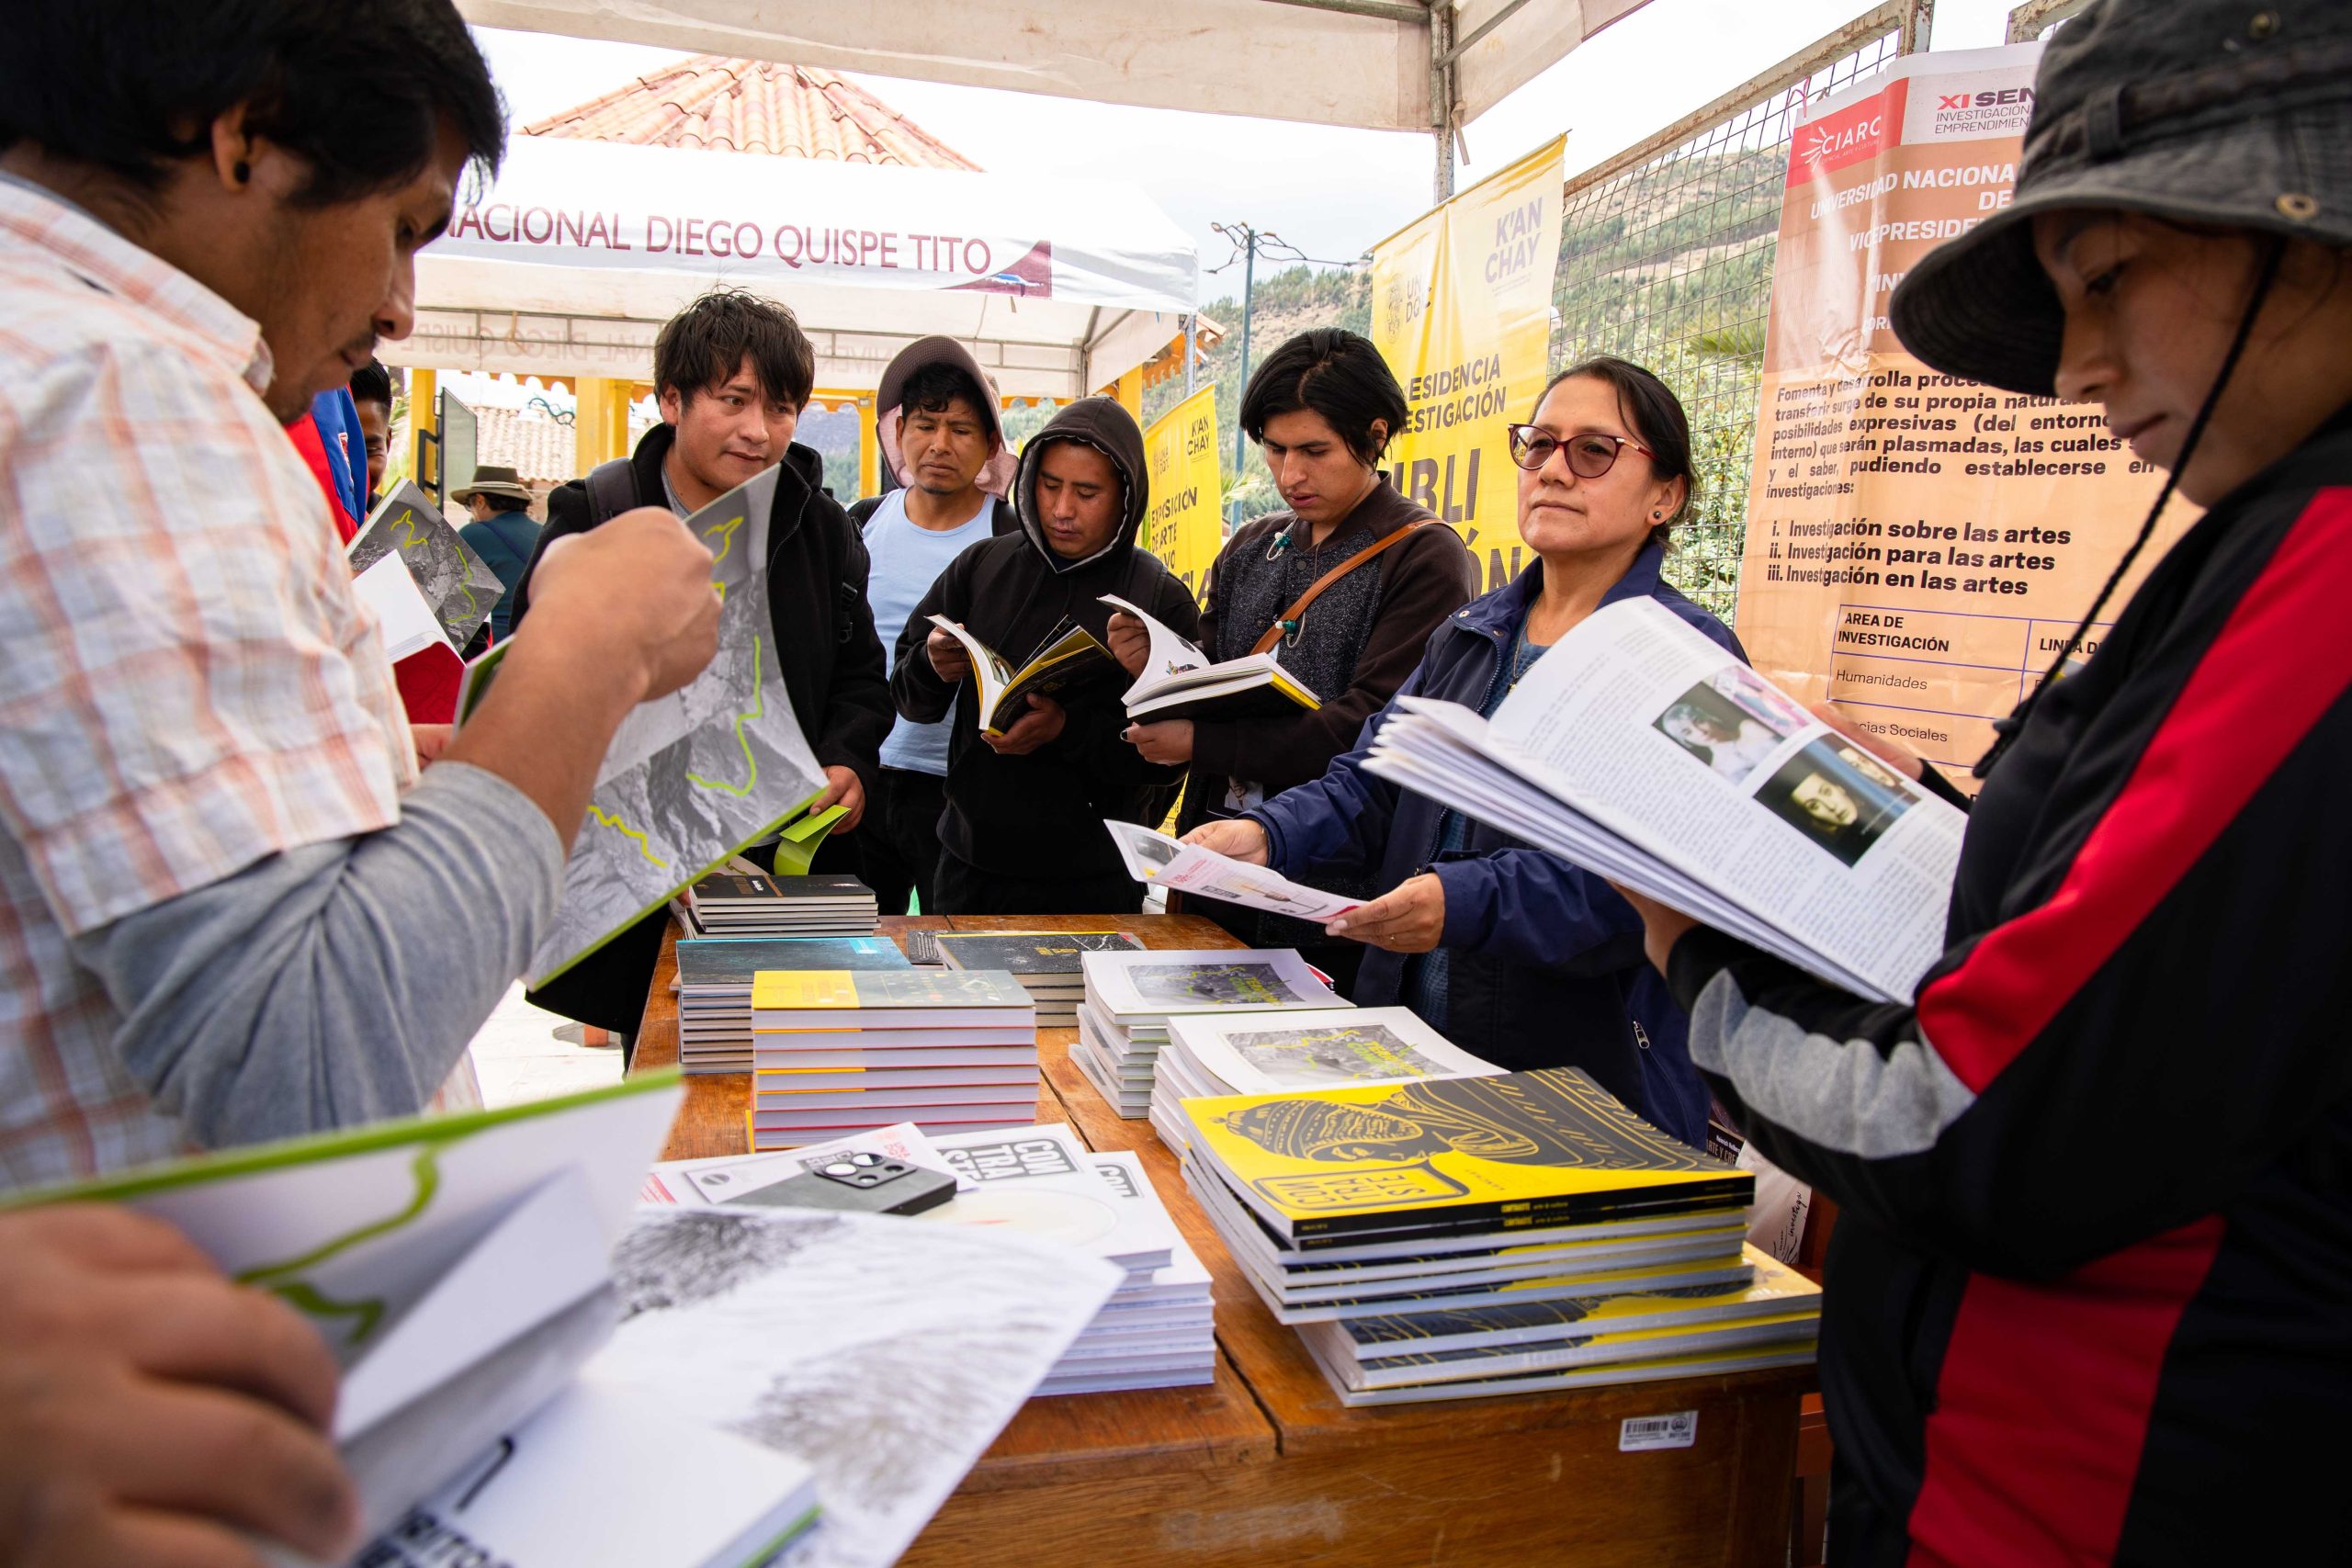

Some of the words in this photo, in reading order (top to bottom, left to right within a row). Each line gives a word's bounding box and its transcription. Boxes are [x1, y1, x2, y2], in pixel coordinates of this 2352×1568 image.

[1937, 93, 1971, 110] XI
[1903, 163, 2021, 190] NACIONA
[1496, 197, 1543, 247] K'AN
[1849, 218, 1984, 252] VICEPRESIDE
[646, 216, 763, 259] DIEGO
[774, 225, 899, 269] QUISPE
[908, 234, 991, 275] TITO
[1485, 231, 1542, 285] CHAY
[1404, 353, 1501, 402] ESIDENCIA
[1778, 382, 1827, 402] Fomenta
[1829, 382, 1835, 398] y
[1838, 370, 1912, 393] desarrolla
[1776, 400, 1829, 422] transferir
[1832, 397, 1860, 414] surge
[1864, 392, 1887, 409] de
[1894, 395, 1919, 409] su
[1926, 392, 1996, 412] propia
[1773, 419, 1843, 444] posibilidades
[1849, 414, 1957, 433] expresivas
[1973, 413, 2017, 433] (del
[1187, 433, 1210, 457] CHAY
[1770, 440, 1817, 460] interno)
[1820, 443, 1838, 459] que
[1839, 435, 1877, 454] serán
[1883, 434, 2008, 457] plasmadas,
[2014, 436, 2044, 454] las
[2051, 434, 2122, 453] cuales
[1769, 468, 1777, 482] y
[1788, 463, 1799, 479] el
[1809, 458, 1839, 477] saber,
[1849, 457, 1941, 476] pudiendo
[1964, 458, 2107, 477] establecerse
[2128, 459, 2155, 474] en
[1766, 480, 1855, 501] investigaciones:
[1771, 520, 1780, 536] i.
[1789, 518, 1883, 539] Investigación
[1887, 520, 1958, 540] sobre
[1963, 522, 1999, 543] las
[2004, 525, 2072, 545] artes
[1769, 542, 1781, 559] ii.
[1787, 542, 1882, 563] Investigación
[1886, 547, 1941, 566] para
[1947, 547, 1984, 568] las
[1988, 550, 2056, 570] artes
[1767, 564, 1783, 581] iii.
[1884, 570, 1915, 588] en
[1920, 570, 1957, 591] las
[1962, 575, 2029, 595] artes
[1845, 613, 1880, 627] AREA
[1883, 615, 1905, 628] DE
[1838, 630, 1950, 652] INVESTIGACIÓN
[2040, 637, 2083, 654] LINA
[2086, 641, 2102, 654] D
[1836, 668, 1928, 691] Humanidades
[1889, 723, 1948, 742] Sociales
[970, 1145, 1025, 1180] TRA
[1013, 1139, 1071, 1176] CON
[1278, 1181, 1330, 1205] CON
[1324, 1179, 1382, 1201] TRA
[1365, 1174, 1427, 1197] STE
